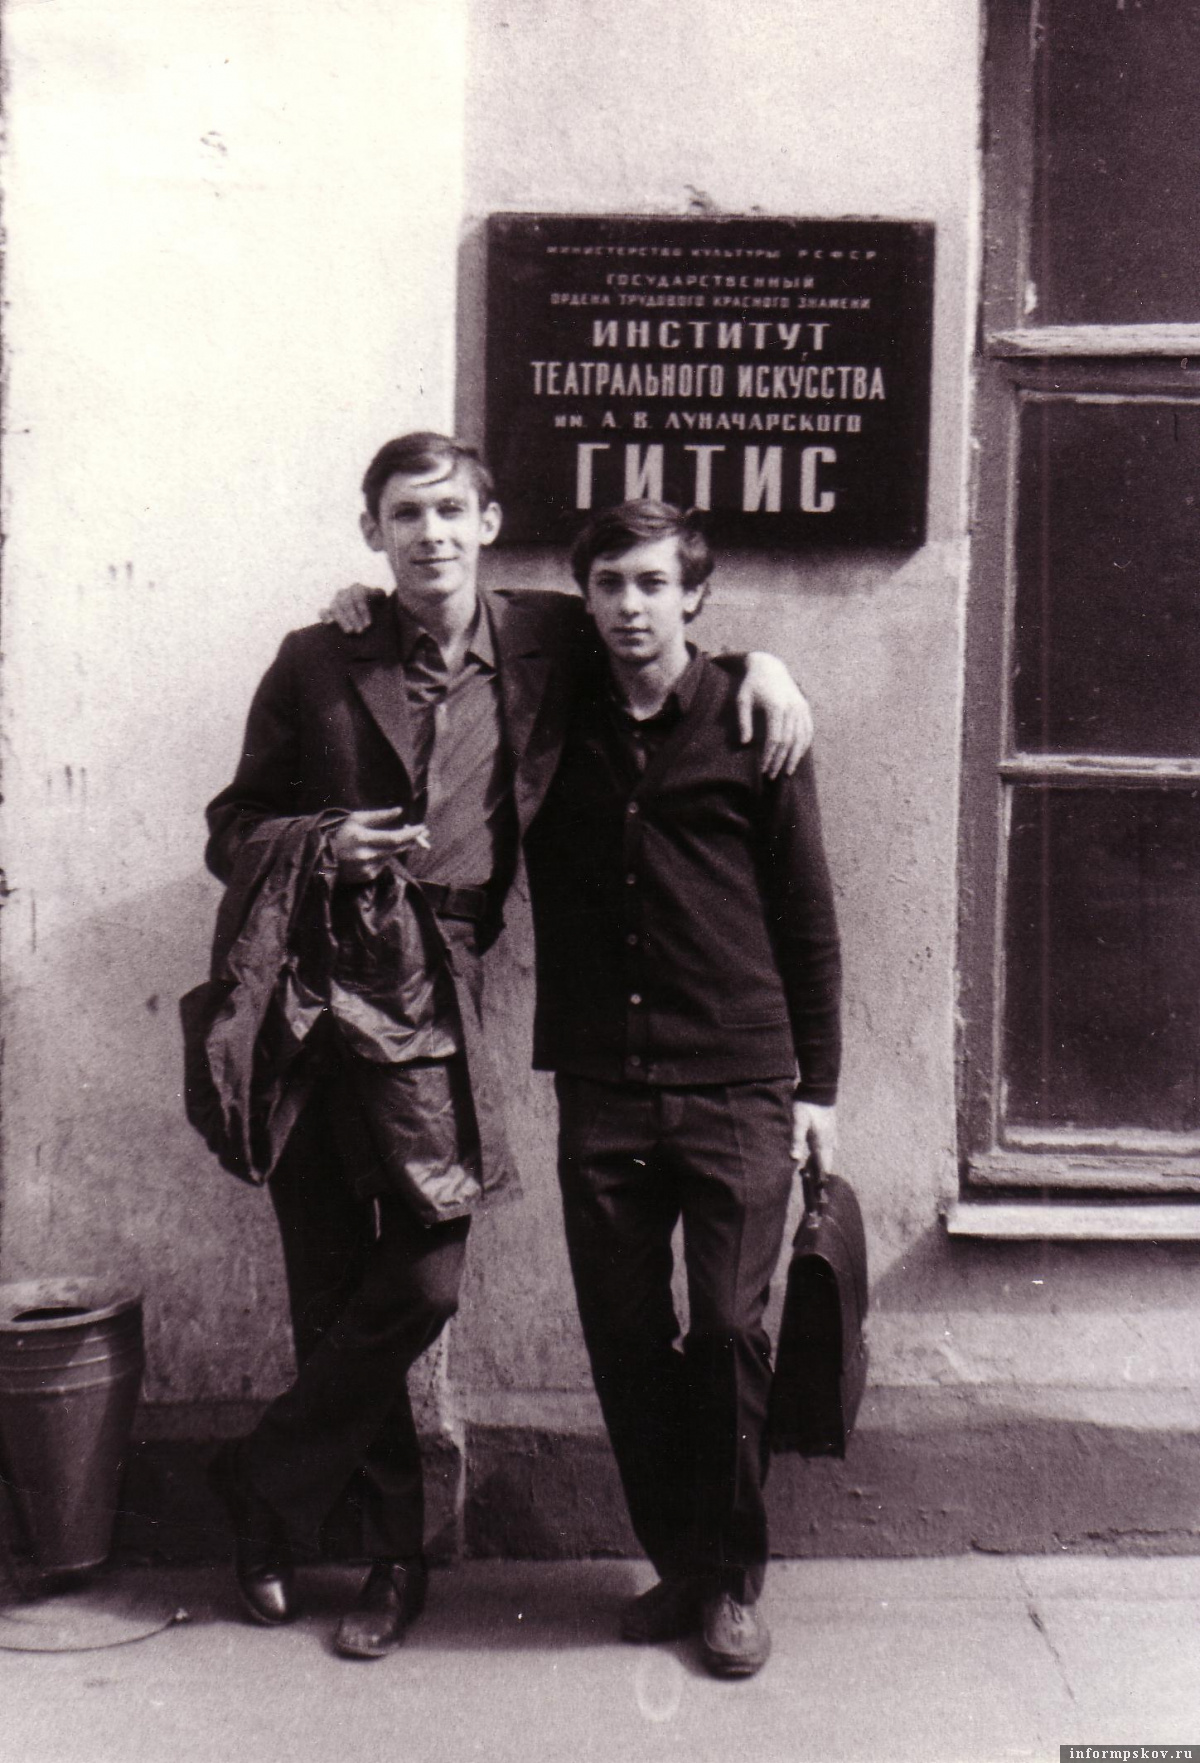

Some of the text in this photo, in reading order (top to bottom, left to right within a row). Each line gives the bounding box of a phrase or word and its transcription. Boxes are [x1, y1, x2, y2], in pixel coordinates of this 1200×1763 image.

[606, 273, 815, 289] ГОСУДАРСТВЕННЫЙ
[550, 292, 871, 310] ОРДЕНА ТРУДОВОГО КРАСНОГО ЗНАМЕНИ
[592, 320, 831, 351] ИНСТИТУТ
[530, 361, 886, 400] ТЕАТРАЛЬНОГО ИСКУССТВА
[664, 411, 862, 433] ЛУНАЧАРСКОГО
[576, 442, 837, 513] ГИТИС
